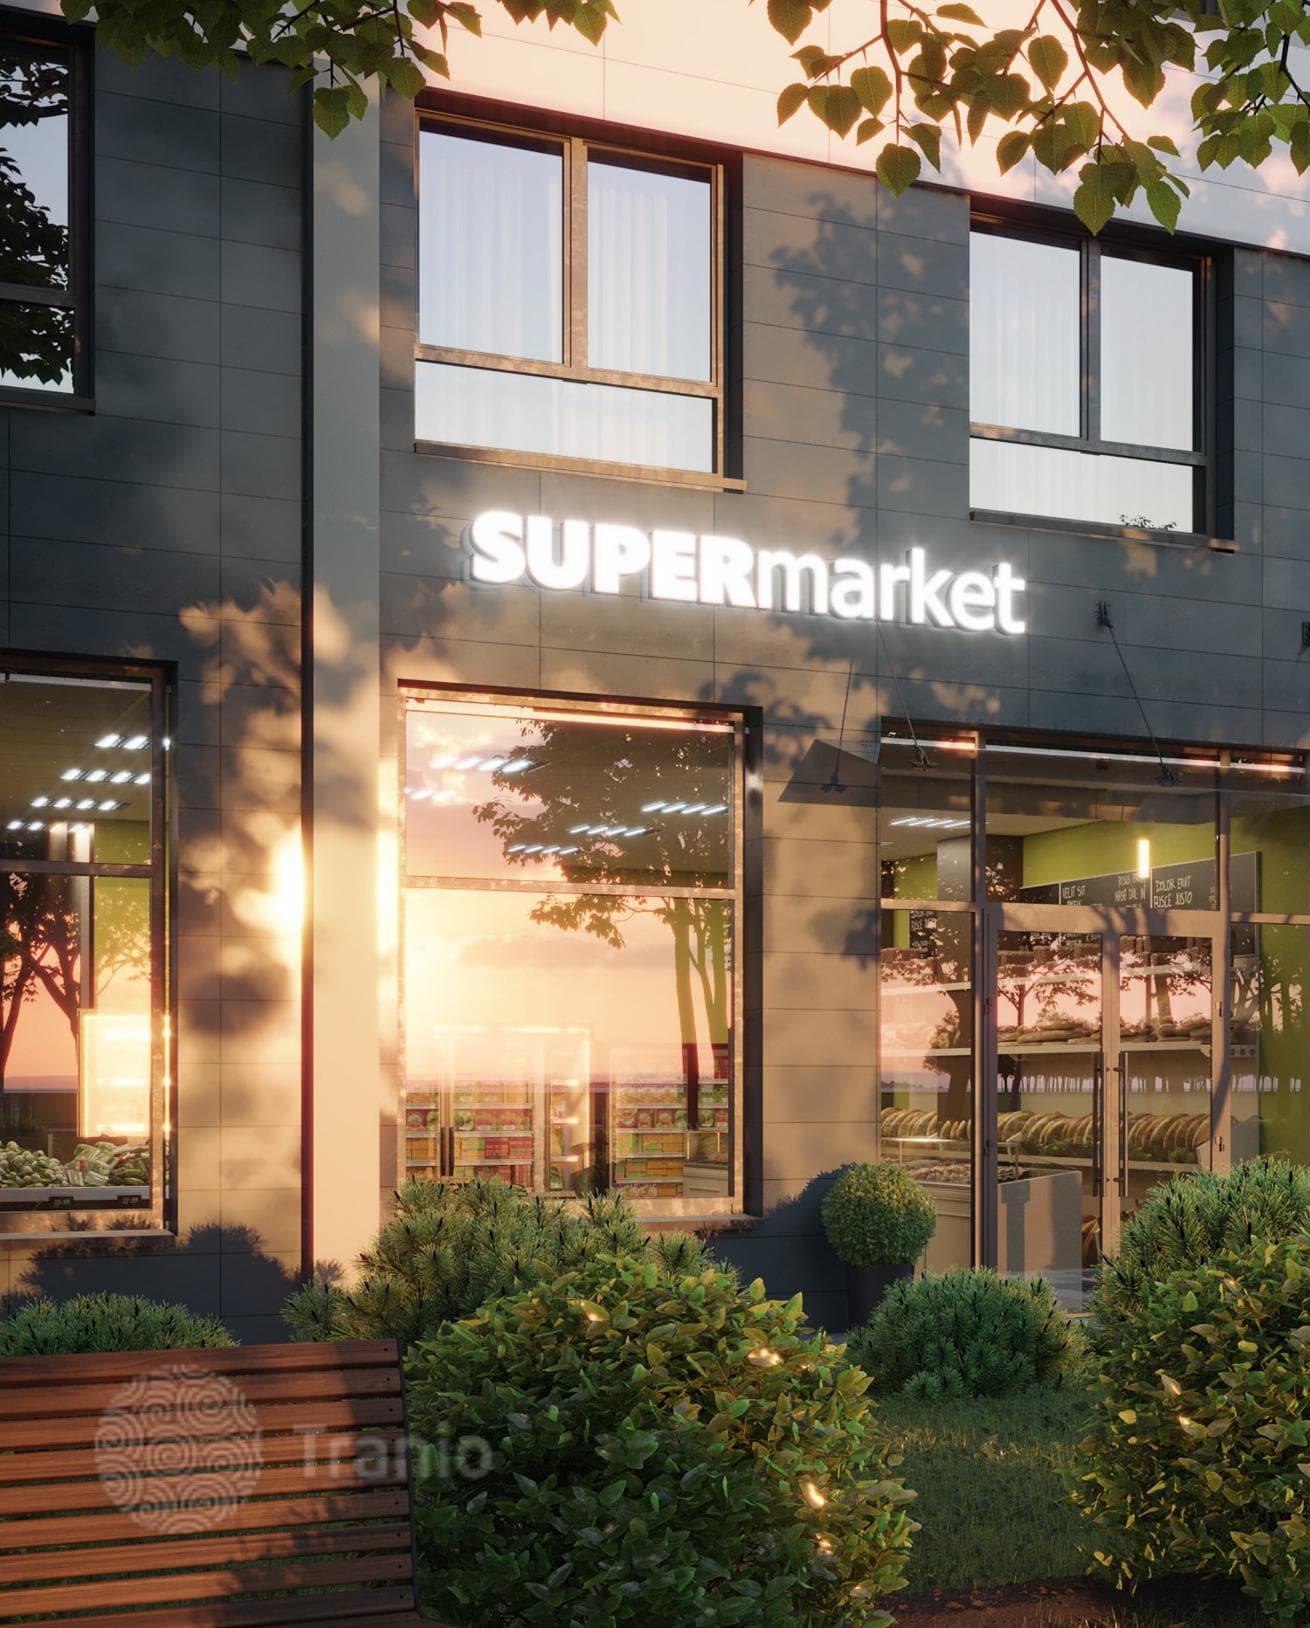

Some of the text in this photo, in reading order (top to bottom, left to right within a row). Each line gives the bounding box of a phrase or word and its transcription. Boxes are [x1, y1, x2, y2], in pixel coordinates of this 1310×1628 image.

[468, 509, 1027, 635] SUPERmarket
[1155, 878, 1176, 893] DOLOR
[1175, 890, 1193, 906] JUSTO
